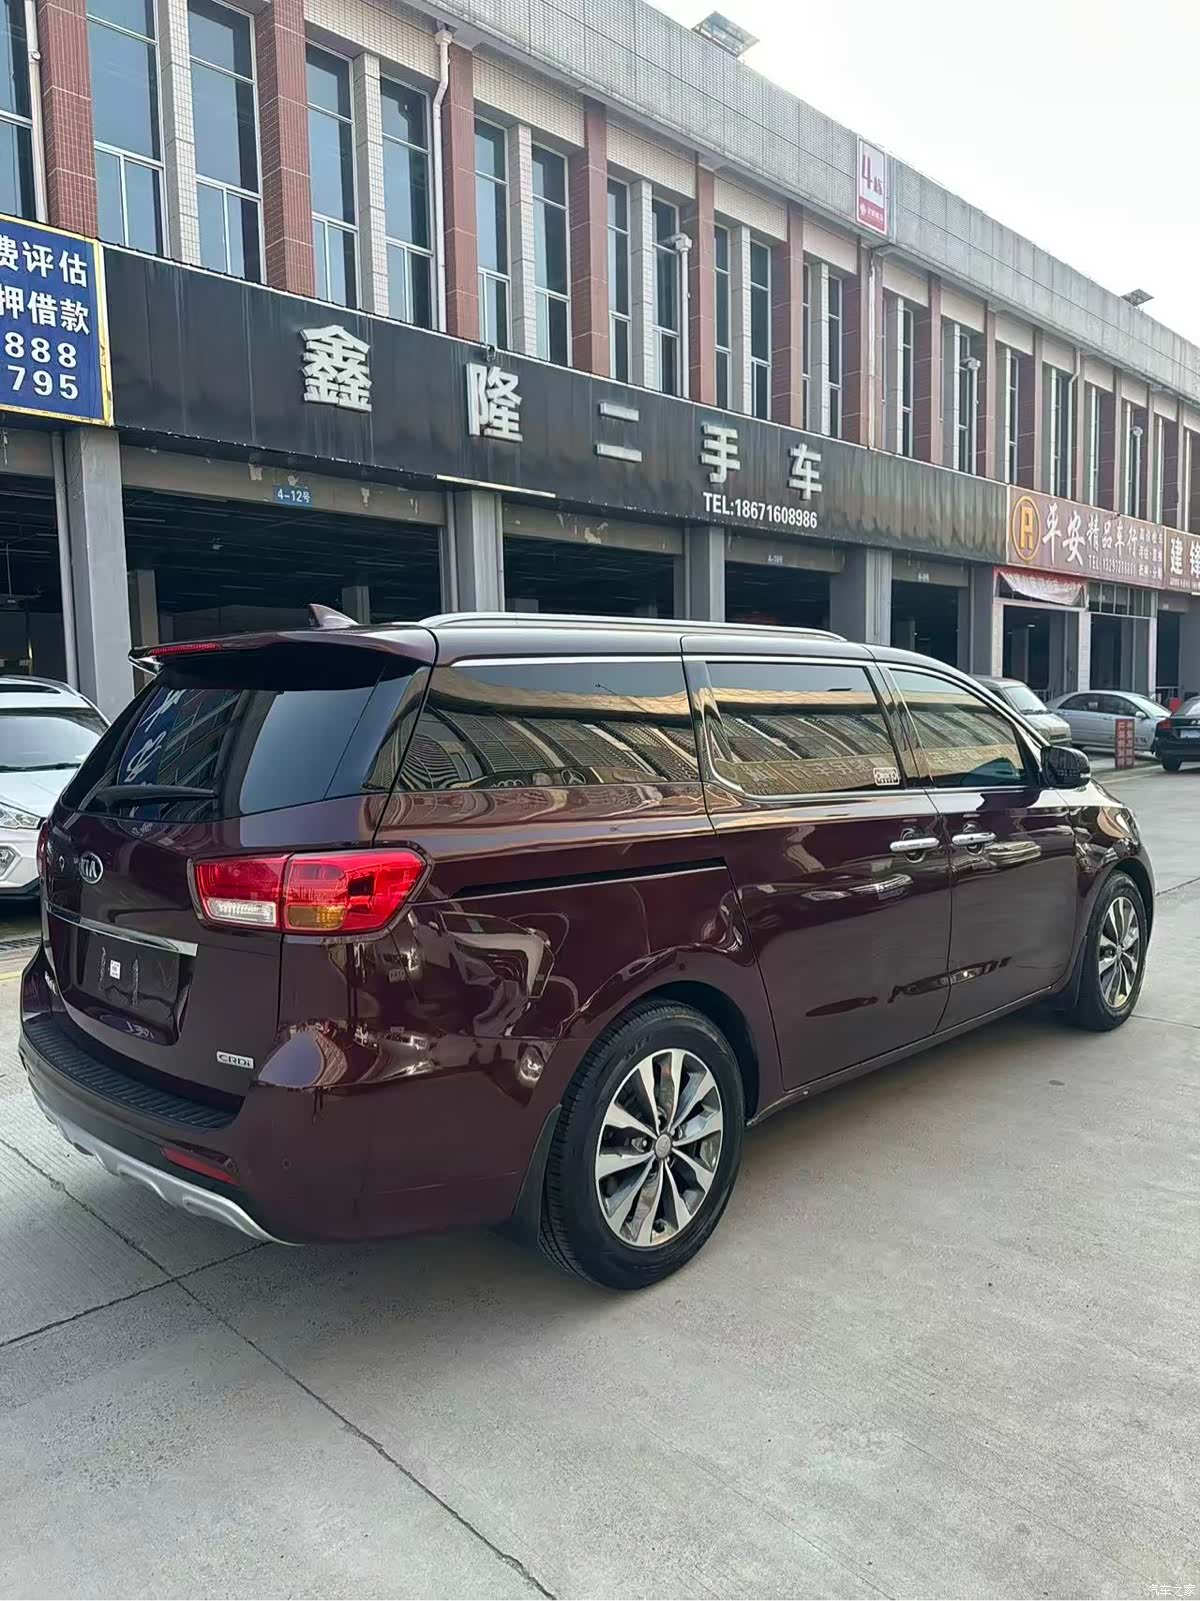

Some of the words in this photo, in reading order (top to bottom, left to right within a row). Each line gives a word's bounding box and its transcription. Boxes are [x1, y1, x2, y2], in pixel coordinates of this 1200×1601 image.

[0, 234, 88, 288] 费评估
[0, 284, 91, 335] 押借款
[5, 331, 77, 369] 888
[8, 365, 79, 400] 795
[300, 325, 823, 501] 鑫隆二手车
[277, 488, 311, 504] 4-12号
[702, 491, 818, 529] TEL:18671608986
[218, 1053, 251, 1068] CRDi
